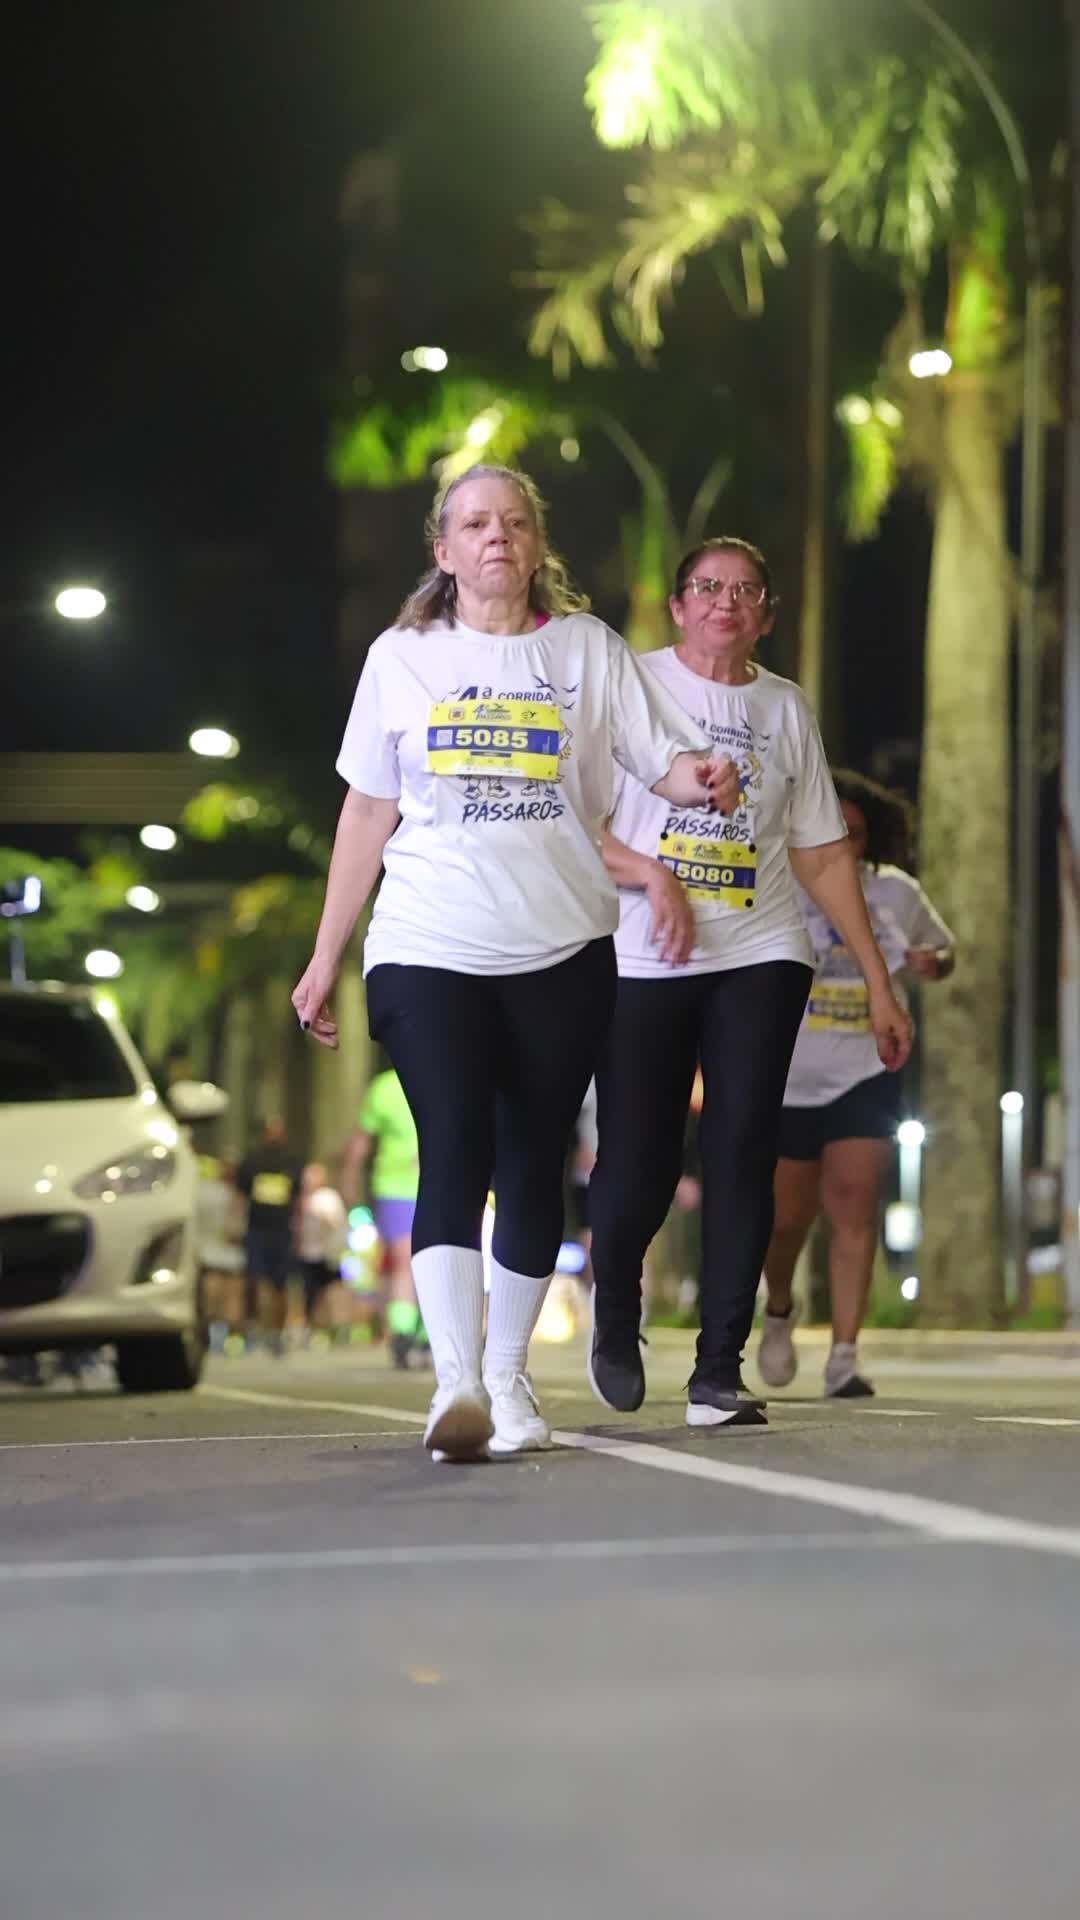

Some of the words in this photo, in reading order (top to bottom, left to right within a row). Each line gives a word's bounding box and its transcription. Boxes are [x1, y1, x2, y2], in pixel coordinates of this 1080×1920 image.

[498, 692, 552, 701] CORRIDA
[455, 729, 528, 748] 5085
[710, 724, 751, 741] CORRIDA
[462, 801, 565, 823] PÁSSAROS
[664, 815, 750, 842] PÁSSAROS
[676, 862, 734, 885] 5080
